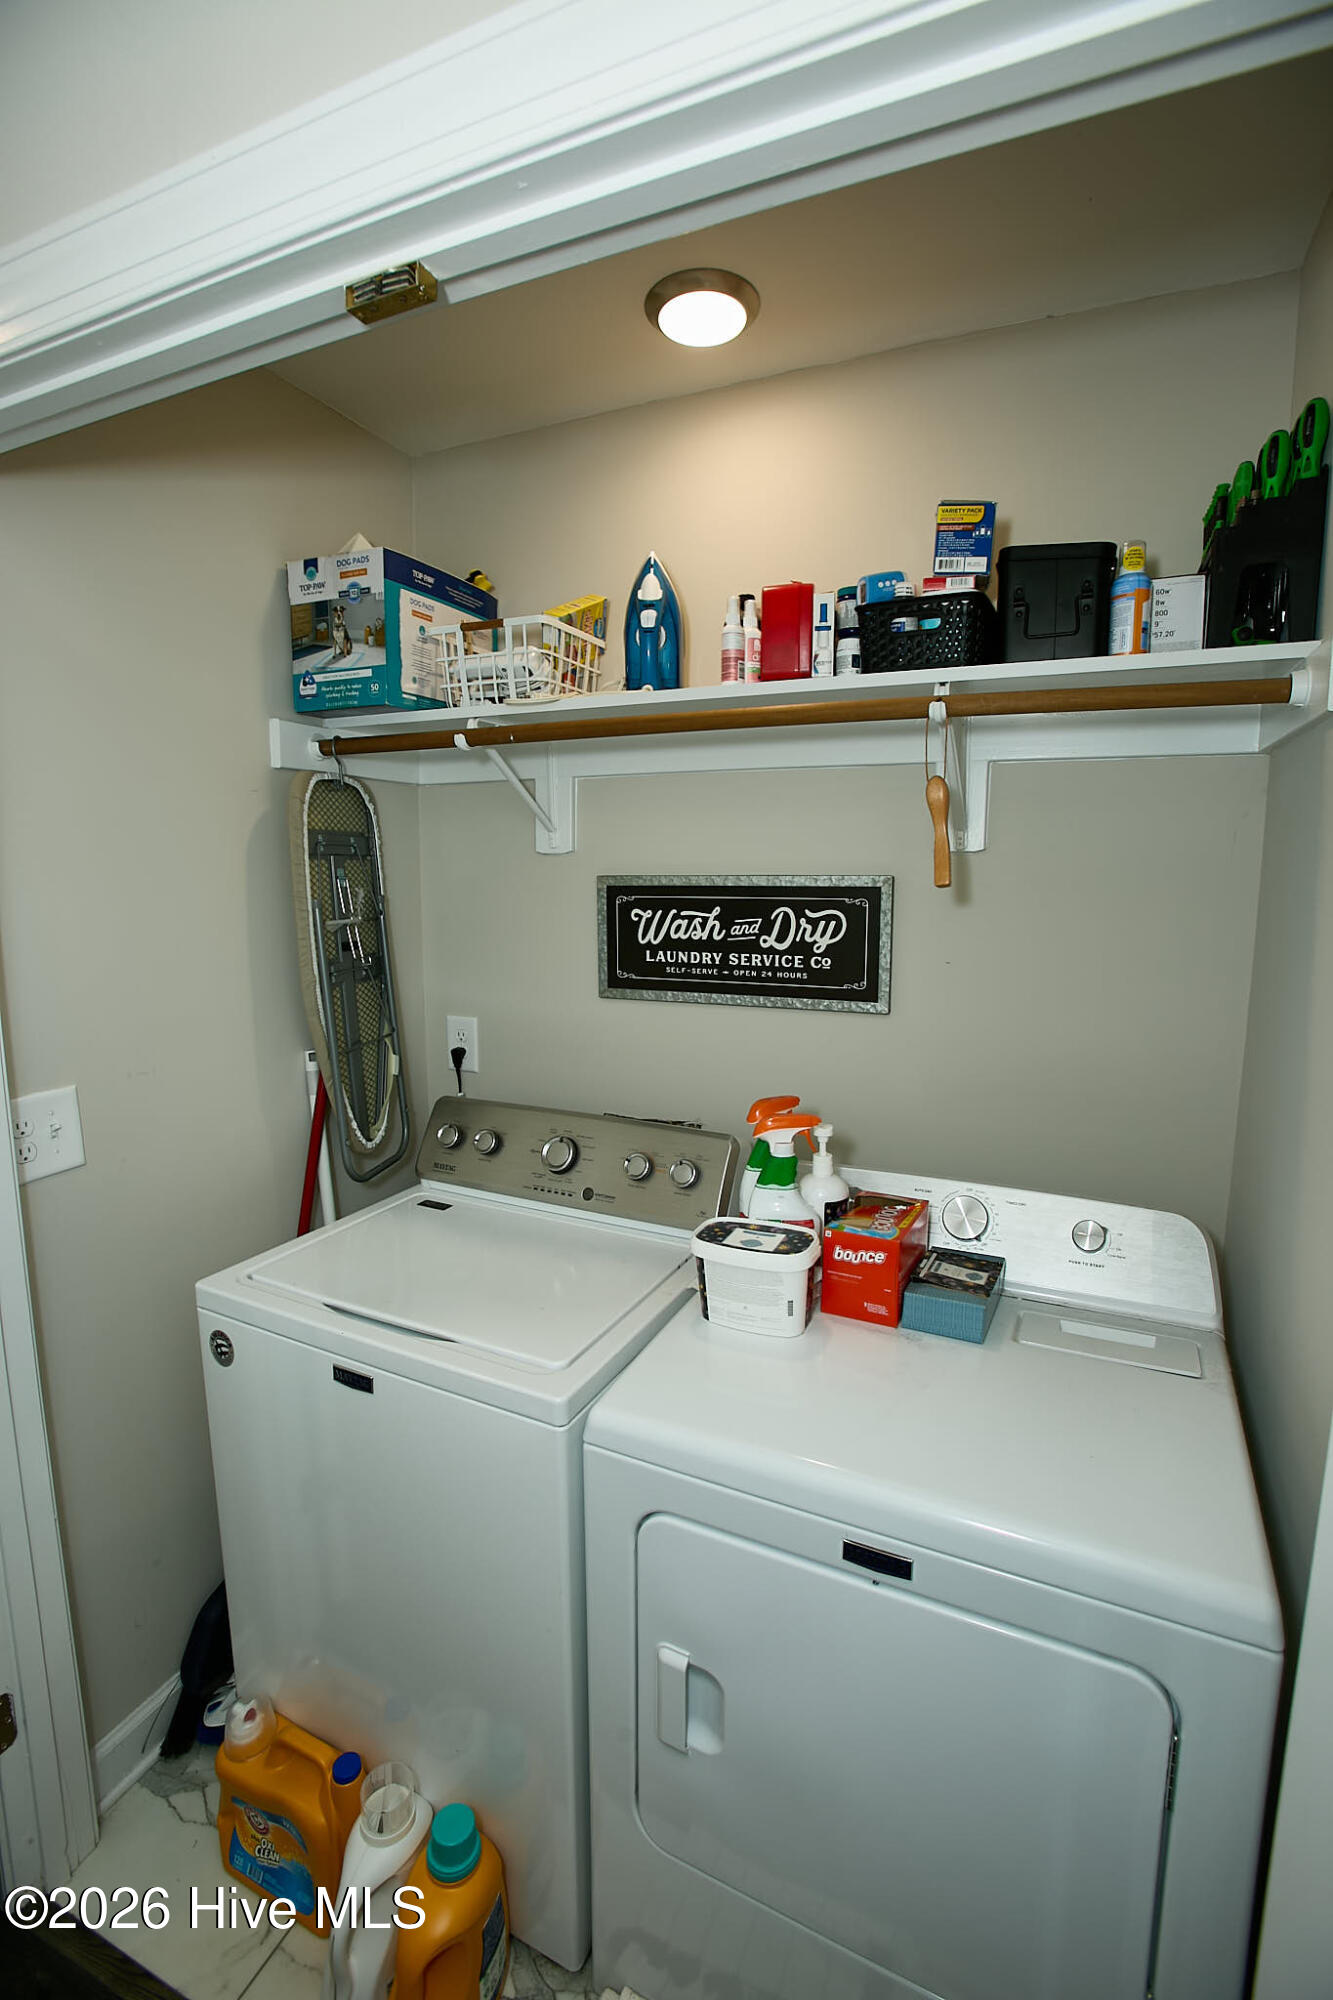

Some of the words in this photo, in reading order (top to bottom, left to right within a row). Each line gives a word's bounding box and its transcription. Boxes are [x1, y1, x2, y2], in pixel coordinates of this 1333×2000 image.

[336, 559, 352, 568] DOG
[352, 555, 370, 564] PADS
[371, 683, 379, 691] 50
[631, 906, 726, 945] Wash
[730, 918, 762, 935] and
[760, 906, 847, 954] Dry
[645, 949, 722, 965] LAUNDRY
[728, 952, 804, 968] SERVICE
[665, 966, 719, 976] SELF-SERVE
[733, 969, 757, 977] OPEN
[776, 971, 808, 979] HOURS
[834, 1245, 885, 1264] bounce
[261, 1838, 275, 1850] OXI
[255, 1845, 280, 1864] CLEAN
